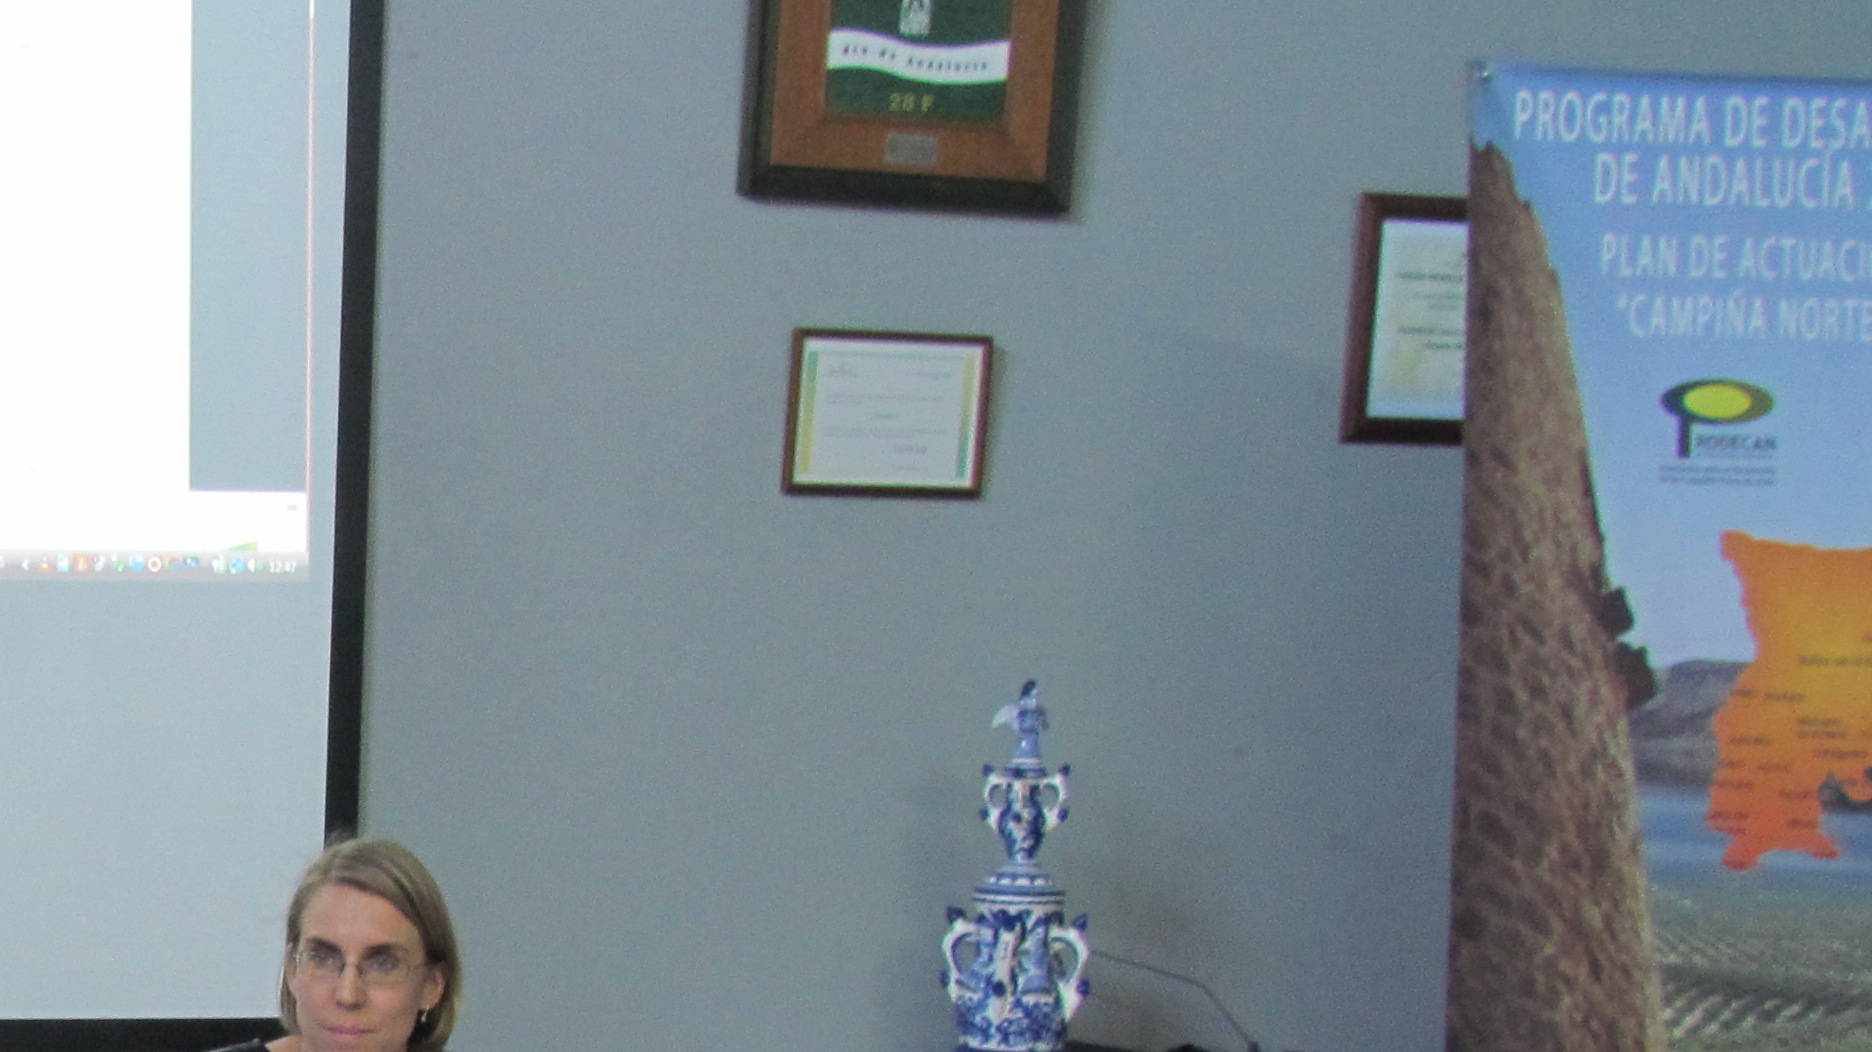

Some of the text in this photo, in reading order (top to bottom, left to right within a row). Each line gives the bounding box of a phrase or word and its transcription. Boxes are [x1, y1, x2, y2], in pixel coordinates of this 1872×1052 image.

[1514, 89, 1711, 146] PROGRAMA
[1723, 96, 1770, 149] DE
[1593, 148, 1855, 210] DE ANDALUCÍA
[1600, 232, 1872, 284] PLAN DE ACTUACI
